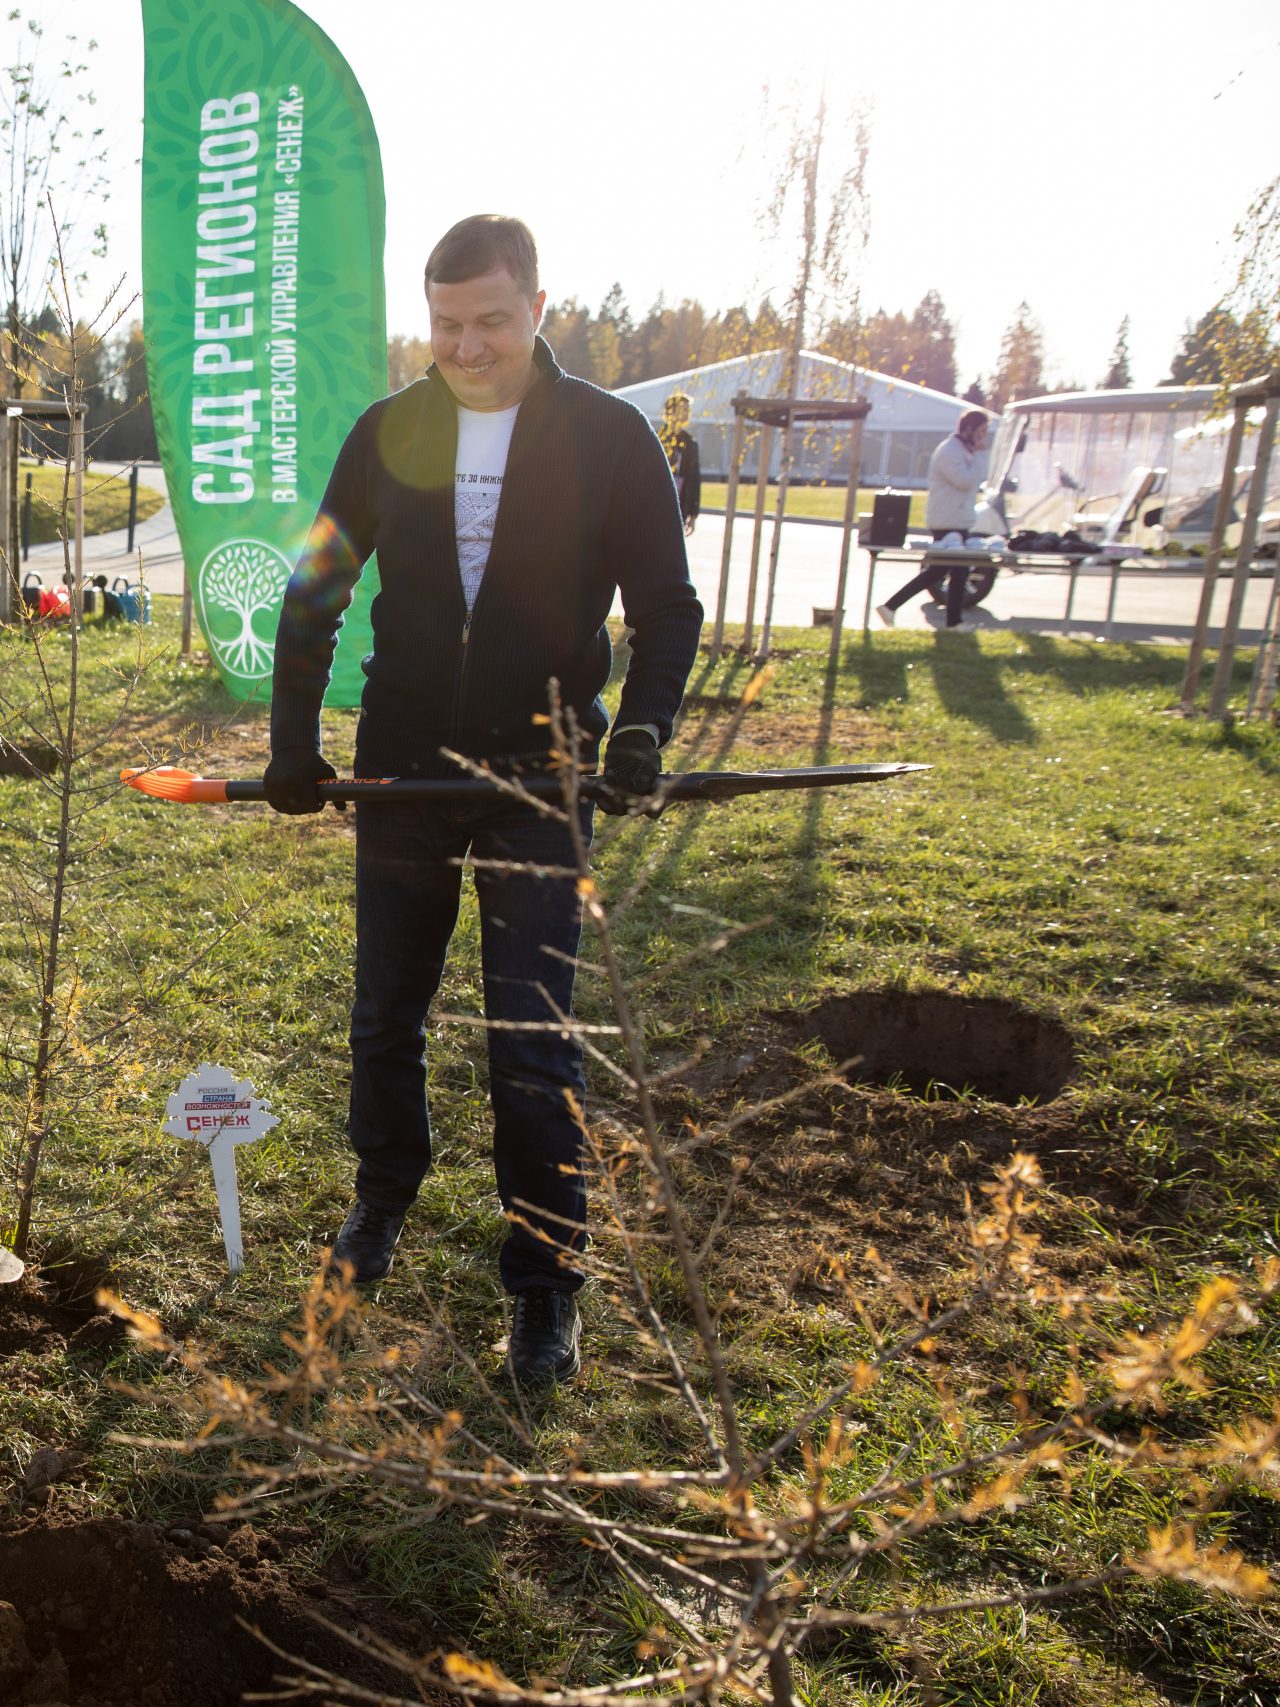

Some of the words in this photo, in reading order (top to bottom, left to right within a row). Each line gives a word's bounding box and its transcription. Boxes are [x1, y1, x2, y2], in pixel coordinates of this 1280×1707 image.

[275, 85, 304, 185] «СЕНЕЖ»
[193, 91, 261, 375] РЕГИОНОВ
[271, 191, 300, 333] УПРАВЛЕНИЯ
[192, 388, 261, 504] САД
[265, 339, 298, 483] МАСТЕРСКОЙ
[272, 488, 298, 503] В
[468, 474, 478, 483] ЗА
[186, 1115, 250, 1132] СЕНЕЖ
